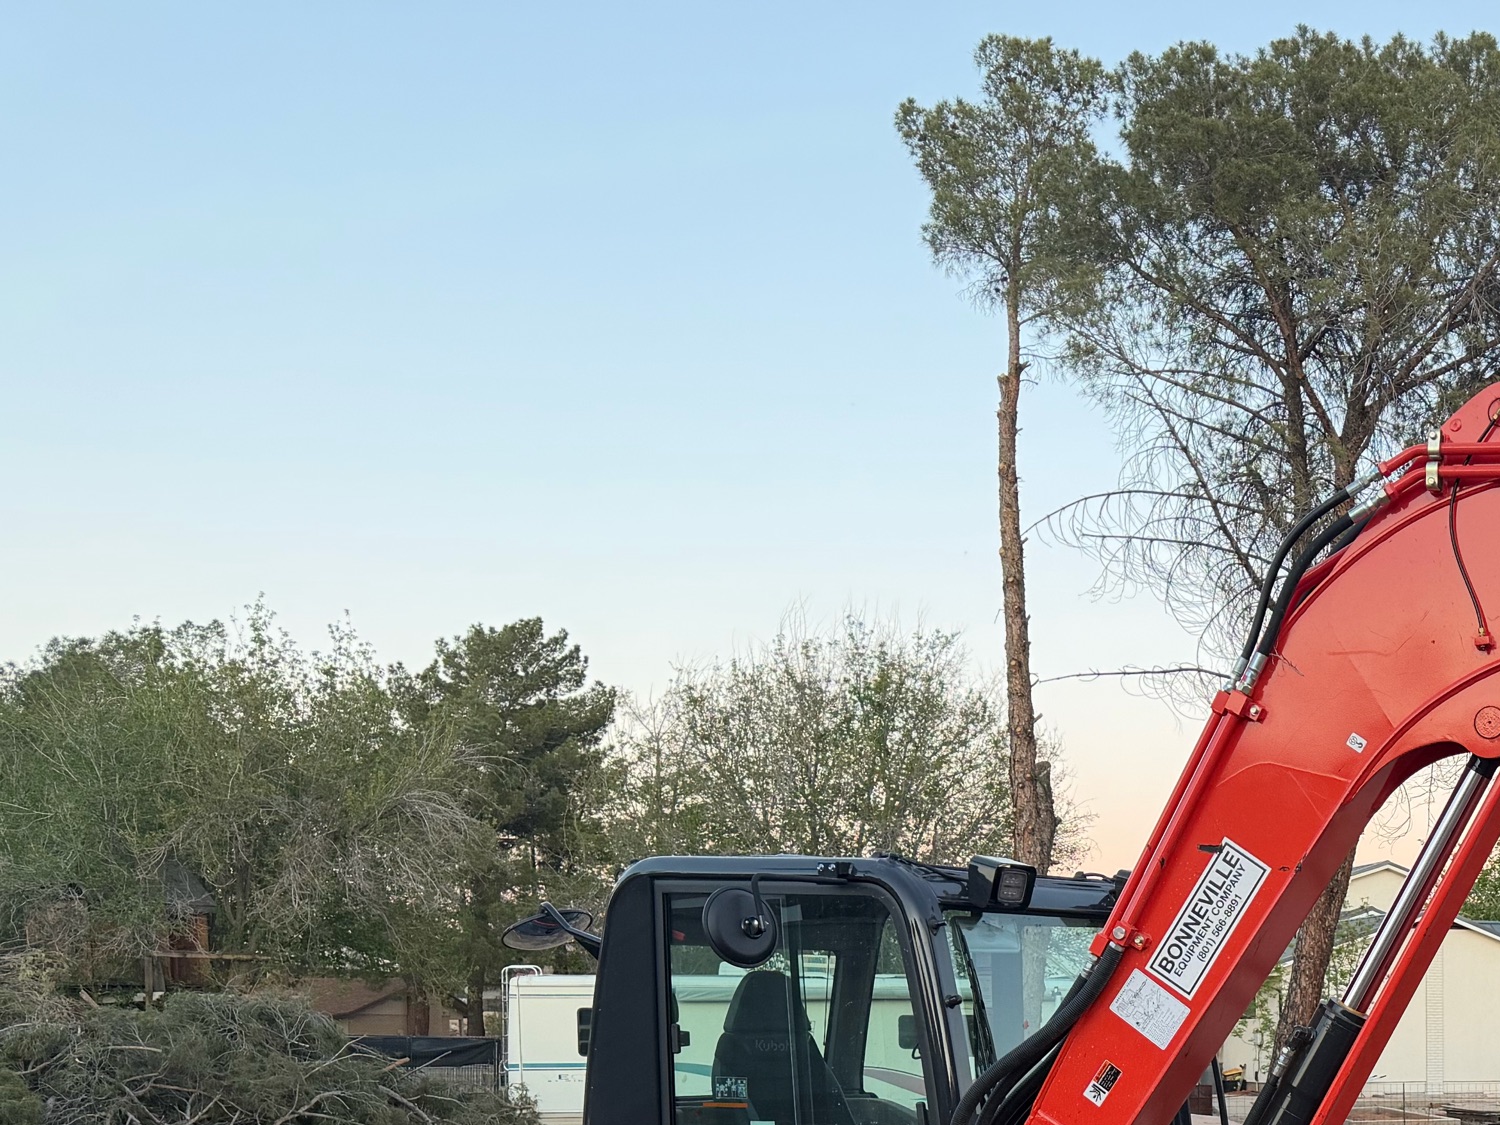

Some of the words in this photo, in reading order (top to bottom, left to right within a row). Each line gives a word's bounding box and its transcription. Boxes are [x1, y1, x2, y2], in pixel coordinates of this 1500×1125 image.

[1158, 851, 1240, 974] BONNEVILLE
[1174, 916, 1214, 977] EQUIPMENT
[1212, 864, 1246, 916] COMPANY
[1196, 938, 1217, 962] (801)
[1212, 894, 1242, 937] 566-8891
